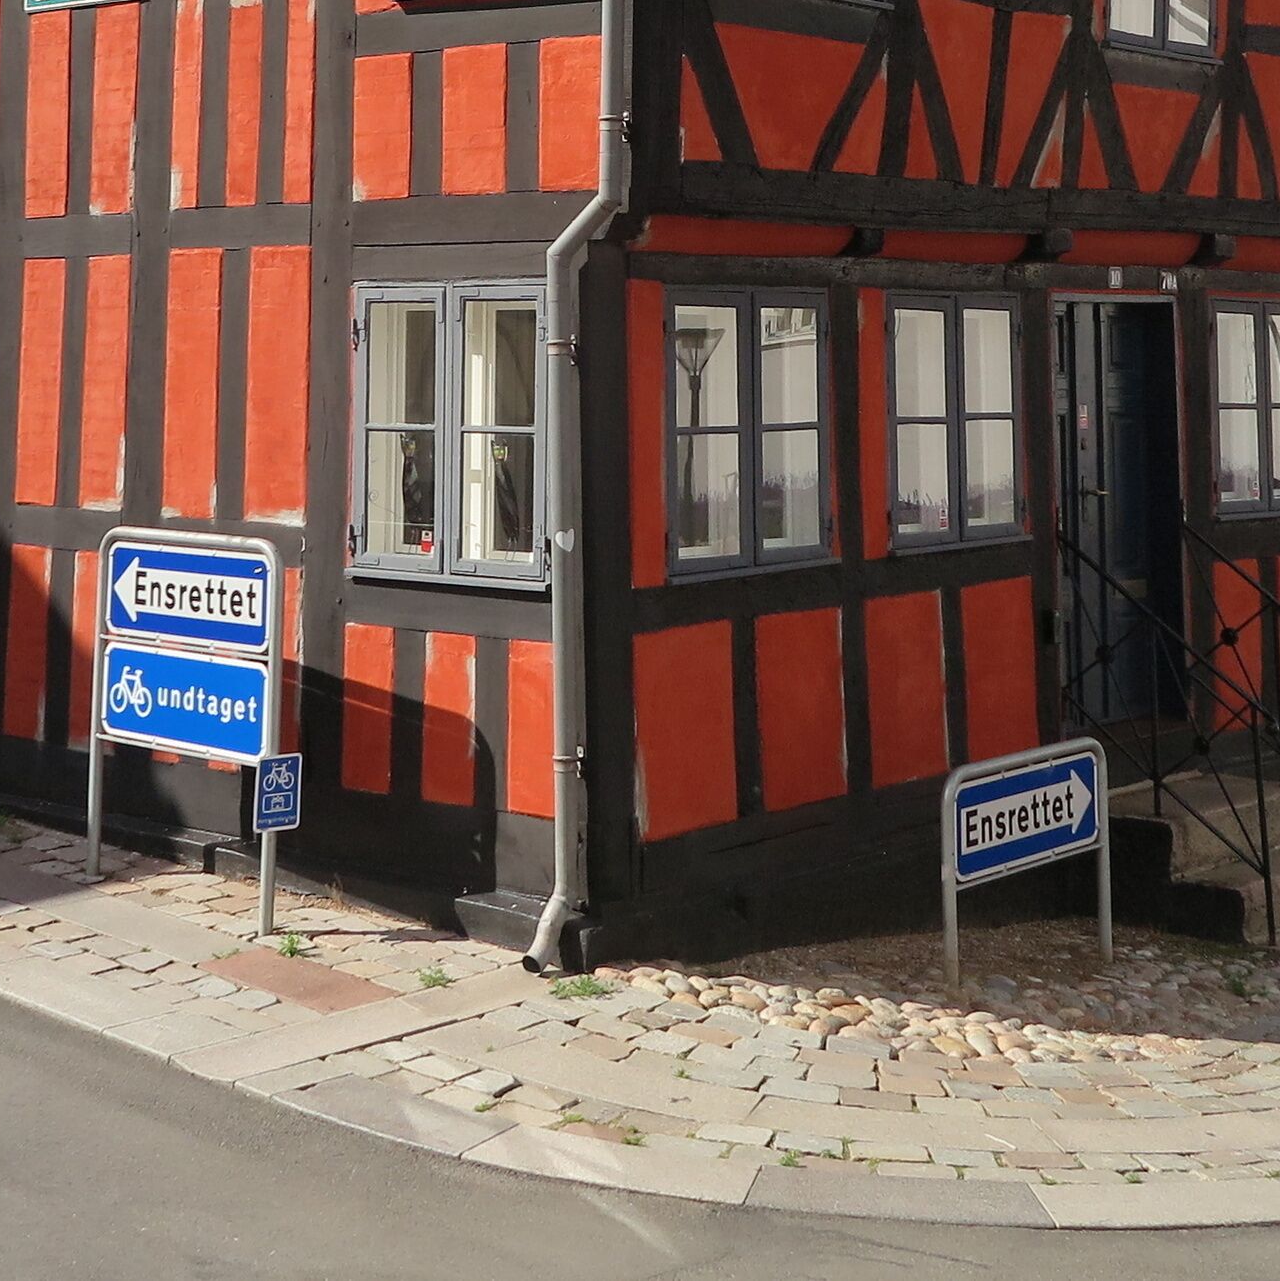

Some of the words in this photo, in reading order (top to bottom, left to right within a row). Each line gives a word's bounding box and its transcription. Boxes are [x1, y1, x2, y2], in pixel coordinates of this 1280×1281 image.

[1111, 270, 1121, 286] 10
[134, 571, 257, 619] Ensrettet
[156, 685, 257, 723] undtaget
[965, 784, 1074, 848] Ensrettet
